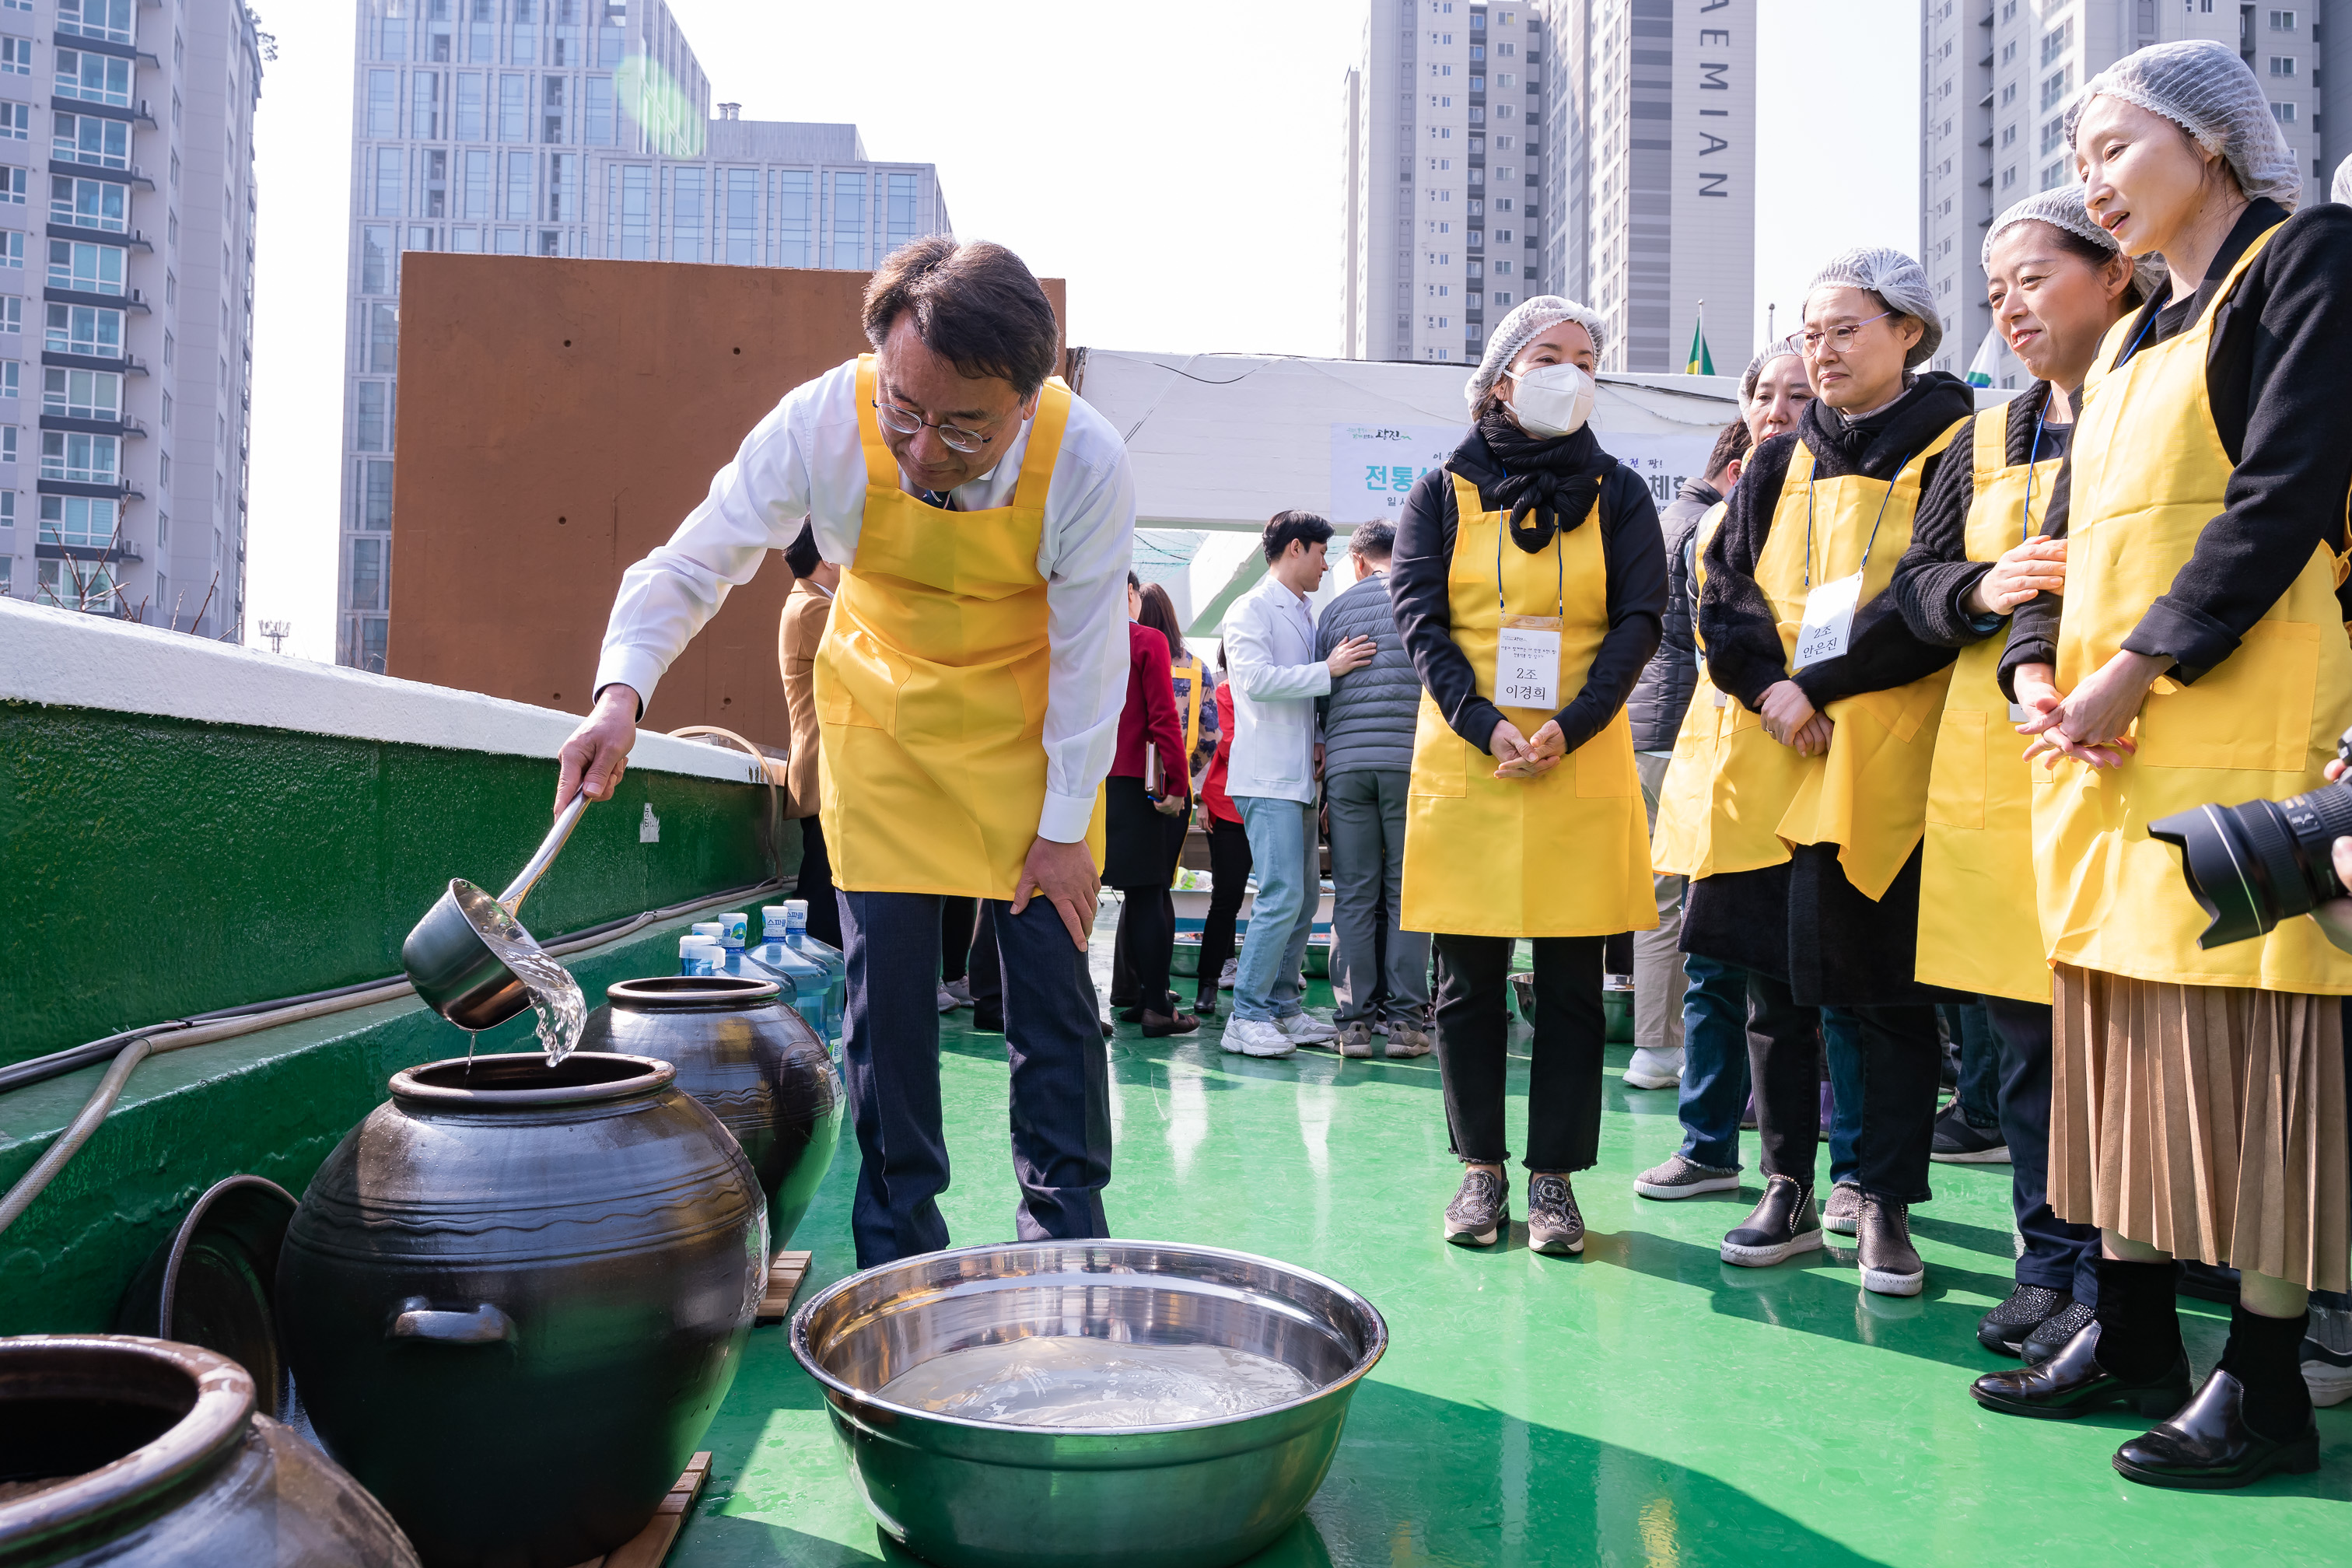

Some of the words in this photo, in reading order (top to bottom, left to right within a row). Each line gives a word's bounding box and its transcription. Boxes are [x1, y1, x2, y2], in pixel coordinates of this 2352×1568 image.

[1375, 429, 1402, 441] 광진
[1647, 458, 1663, 469] 짱!
[1813, 625, 1832, 639] 2조
[1803, 637, 1837, 659] 안은진
[1516, 667, 1538, 681] 2조
[1506, 684, 1546, 701] 이경희
[768, 919, 786, 927] 스파클
